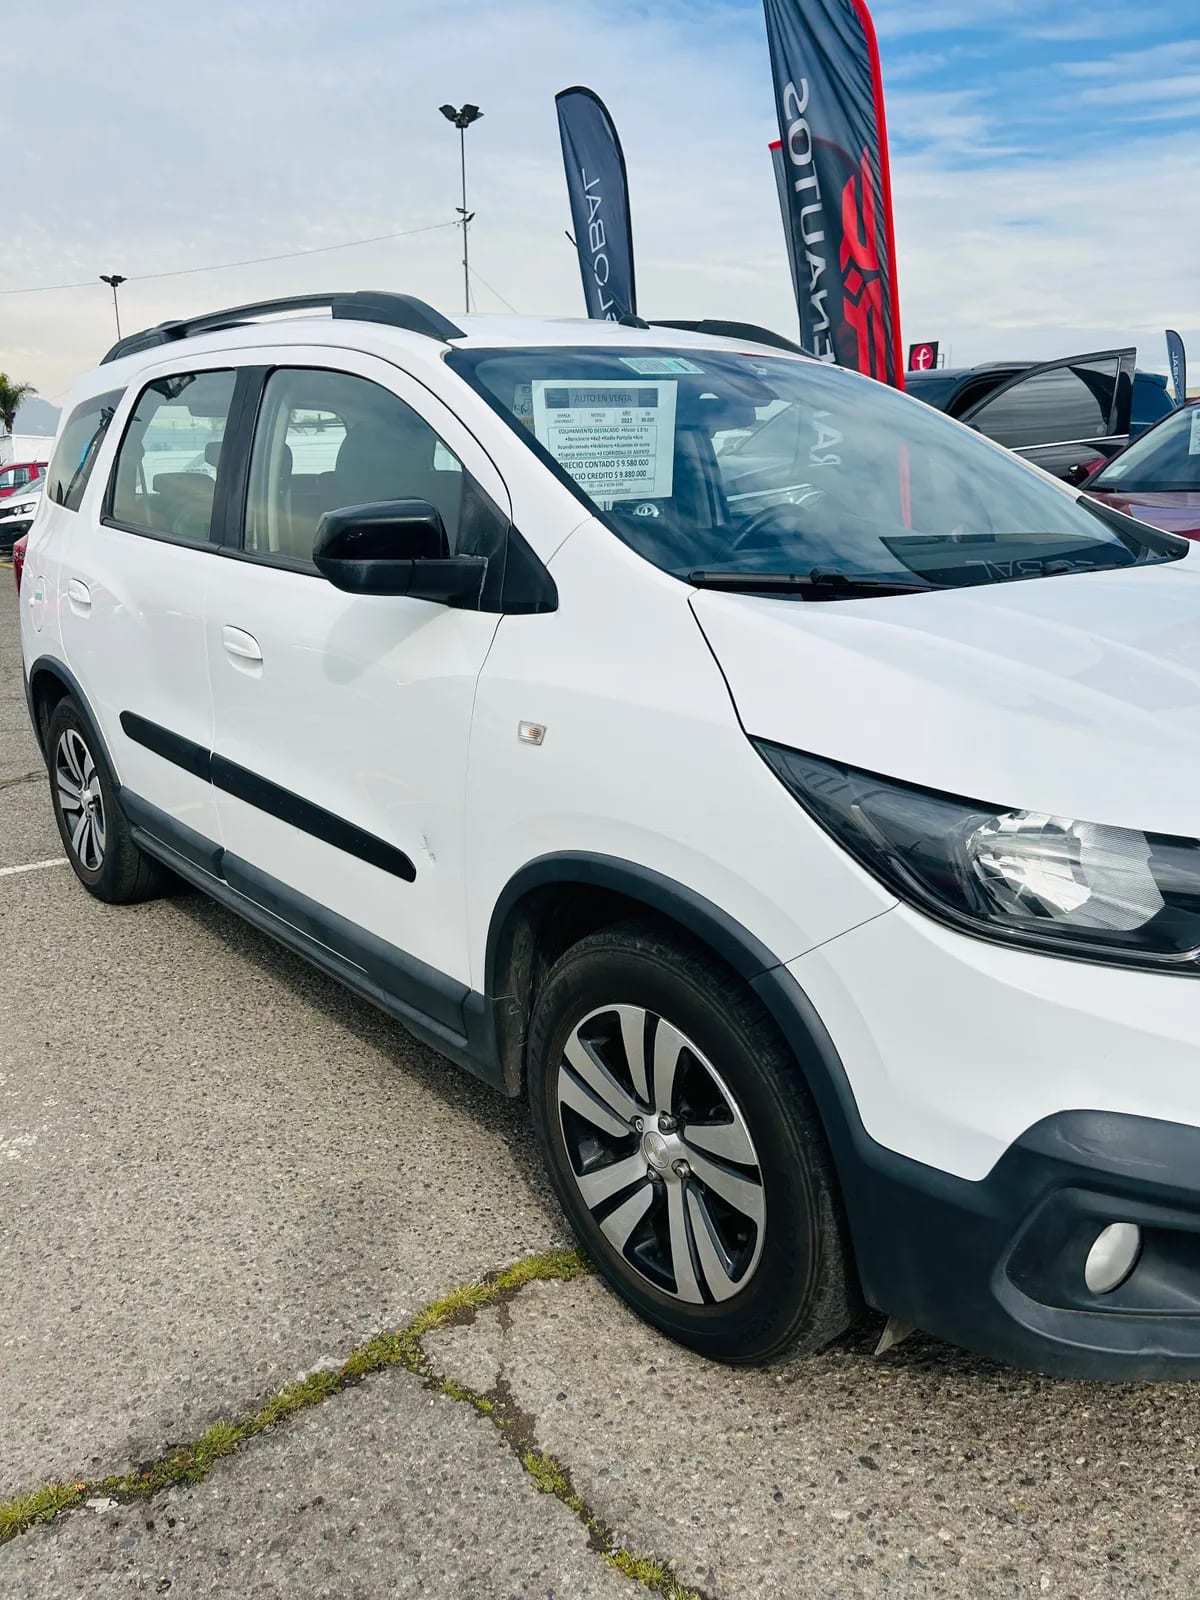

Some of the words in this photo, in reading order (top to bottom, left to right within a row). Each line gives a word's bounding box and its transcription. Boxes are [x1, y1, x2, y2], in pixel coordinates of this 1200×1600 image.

[575, 393, 596, 403] AUTO
[597, 393, 608, 403] EN
[609, 392, 632, 403] VENTA
[584, 460, 615, 469] CONTADO
[616, 460, 621, 468] $
[621, 459, 649, 468] 9.580.000
[571, 472, 586, 480] ECIO
[587, 471, 613, 480] CREDITO
[614, 471, 618, 479] $
